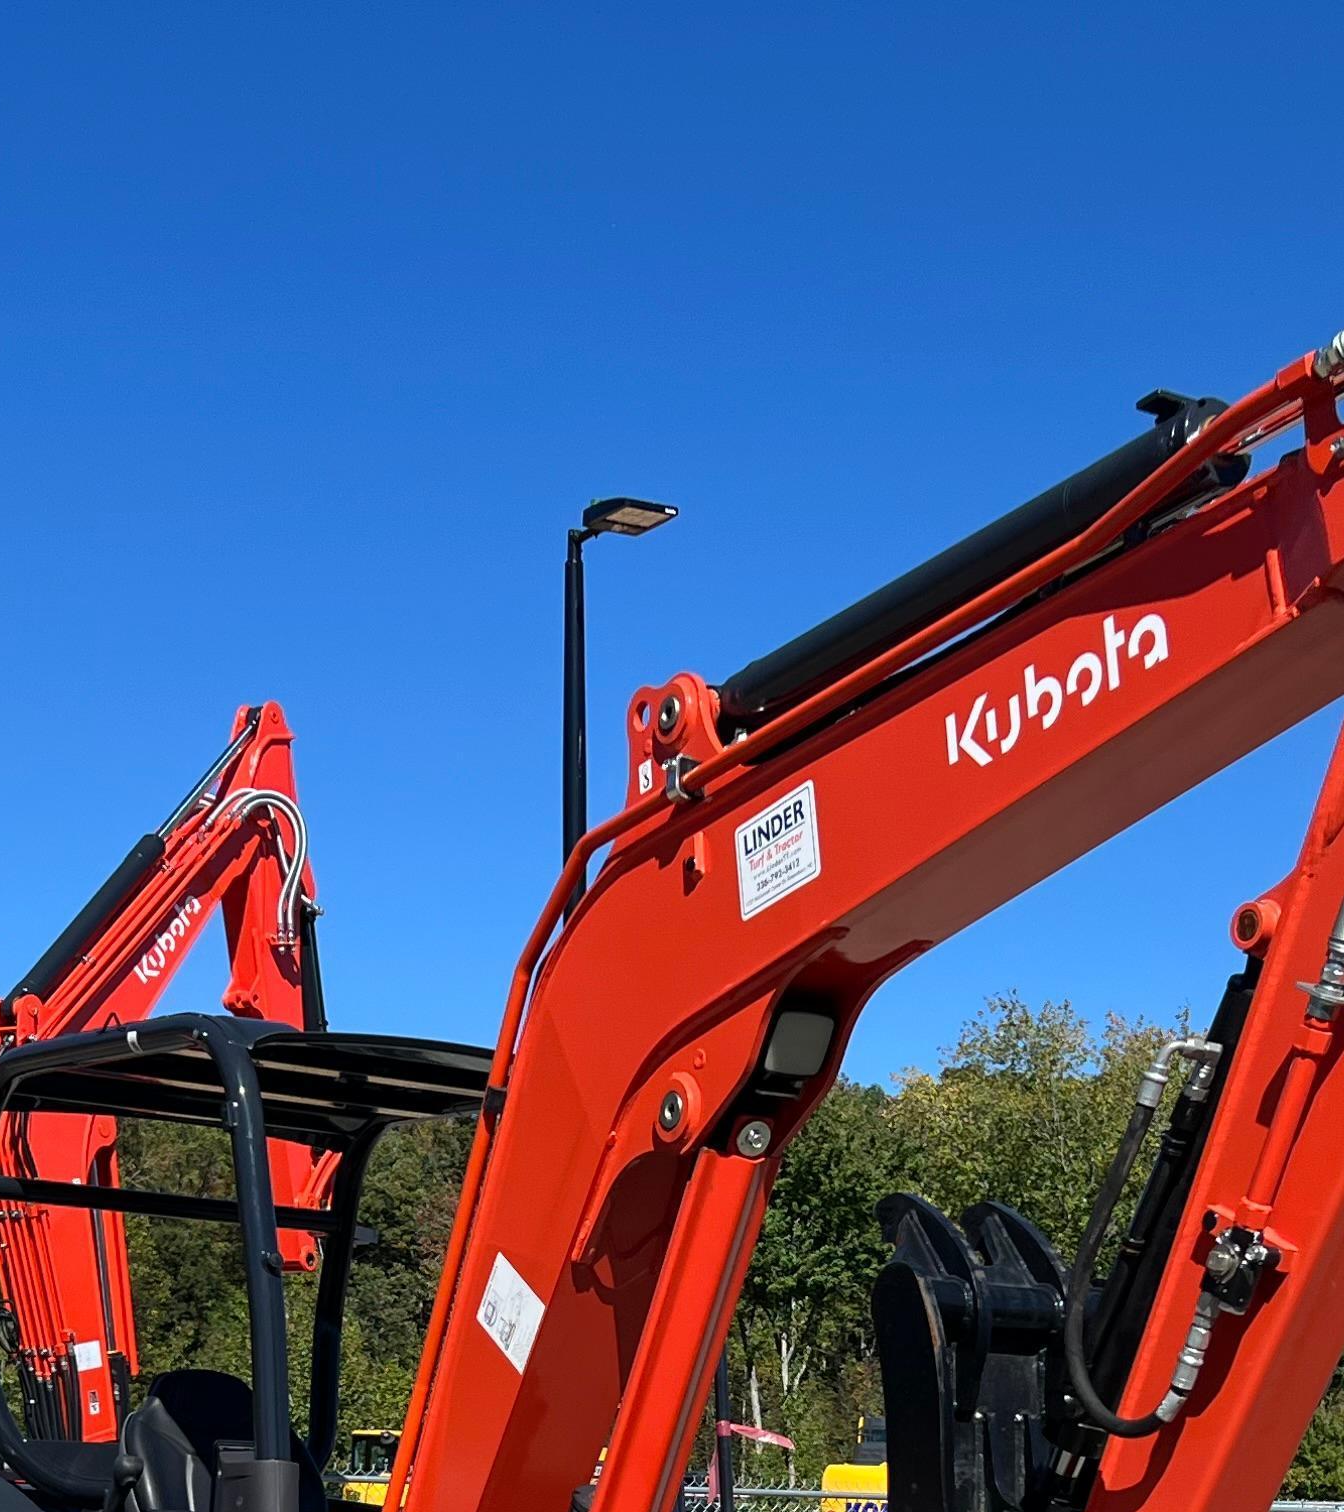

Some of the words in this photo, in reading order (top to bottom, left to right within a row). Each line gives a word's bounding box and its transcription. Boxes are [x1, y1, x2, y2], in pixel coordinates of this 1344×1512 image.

[944, 612, 1168, 767] Kubota
[743, 799, 805, 857] LINDER
[748, 852, 765, 872] Turf
[774, 830, 803, 852] Tractor
[133, 895, 201, 984] Kubota
